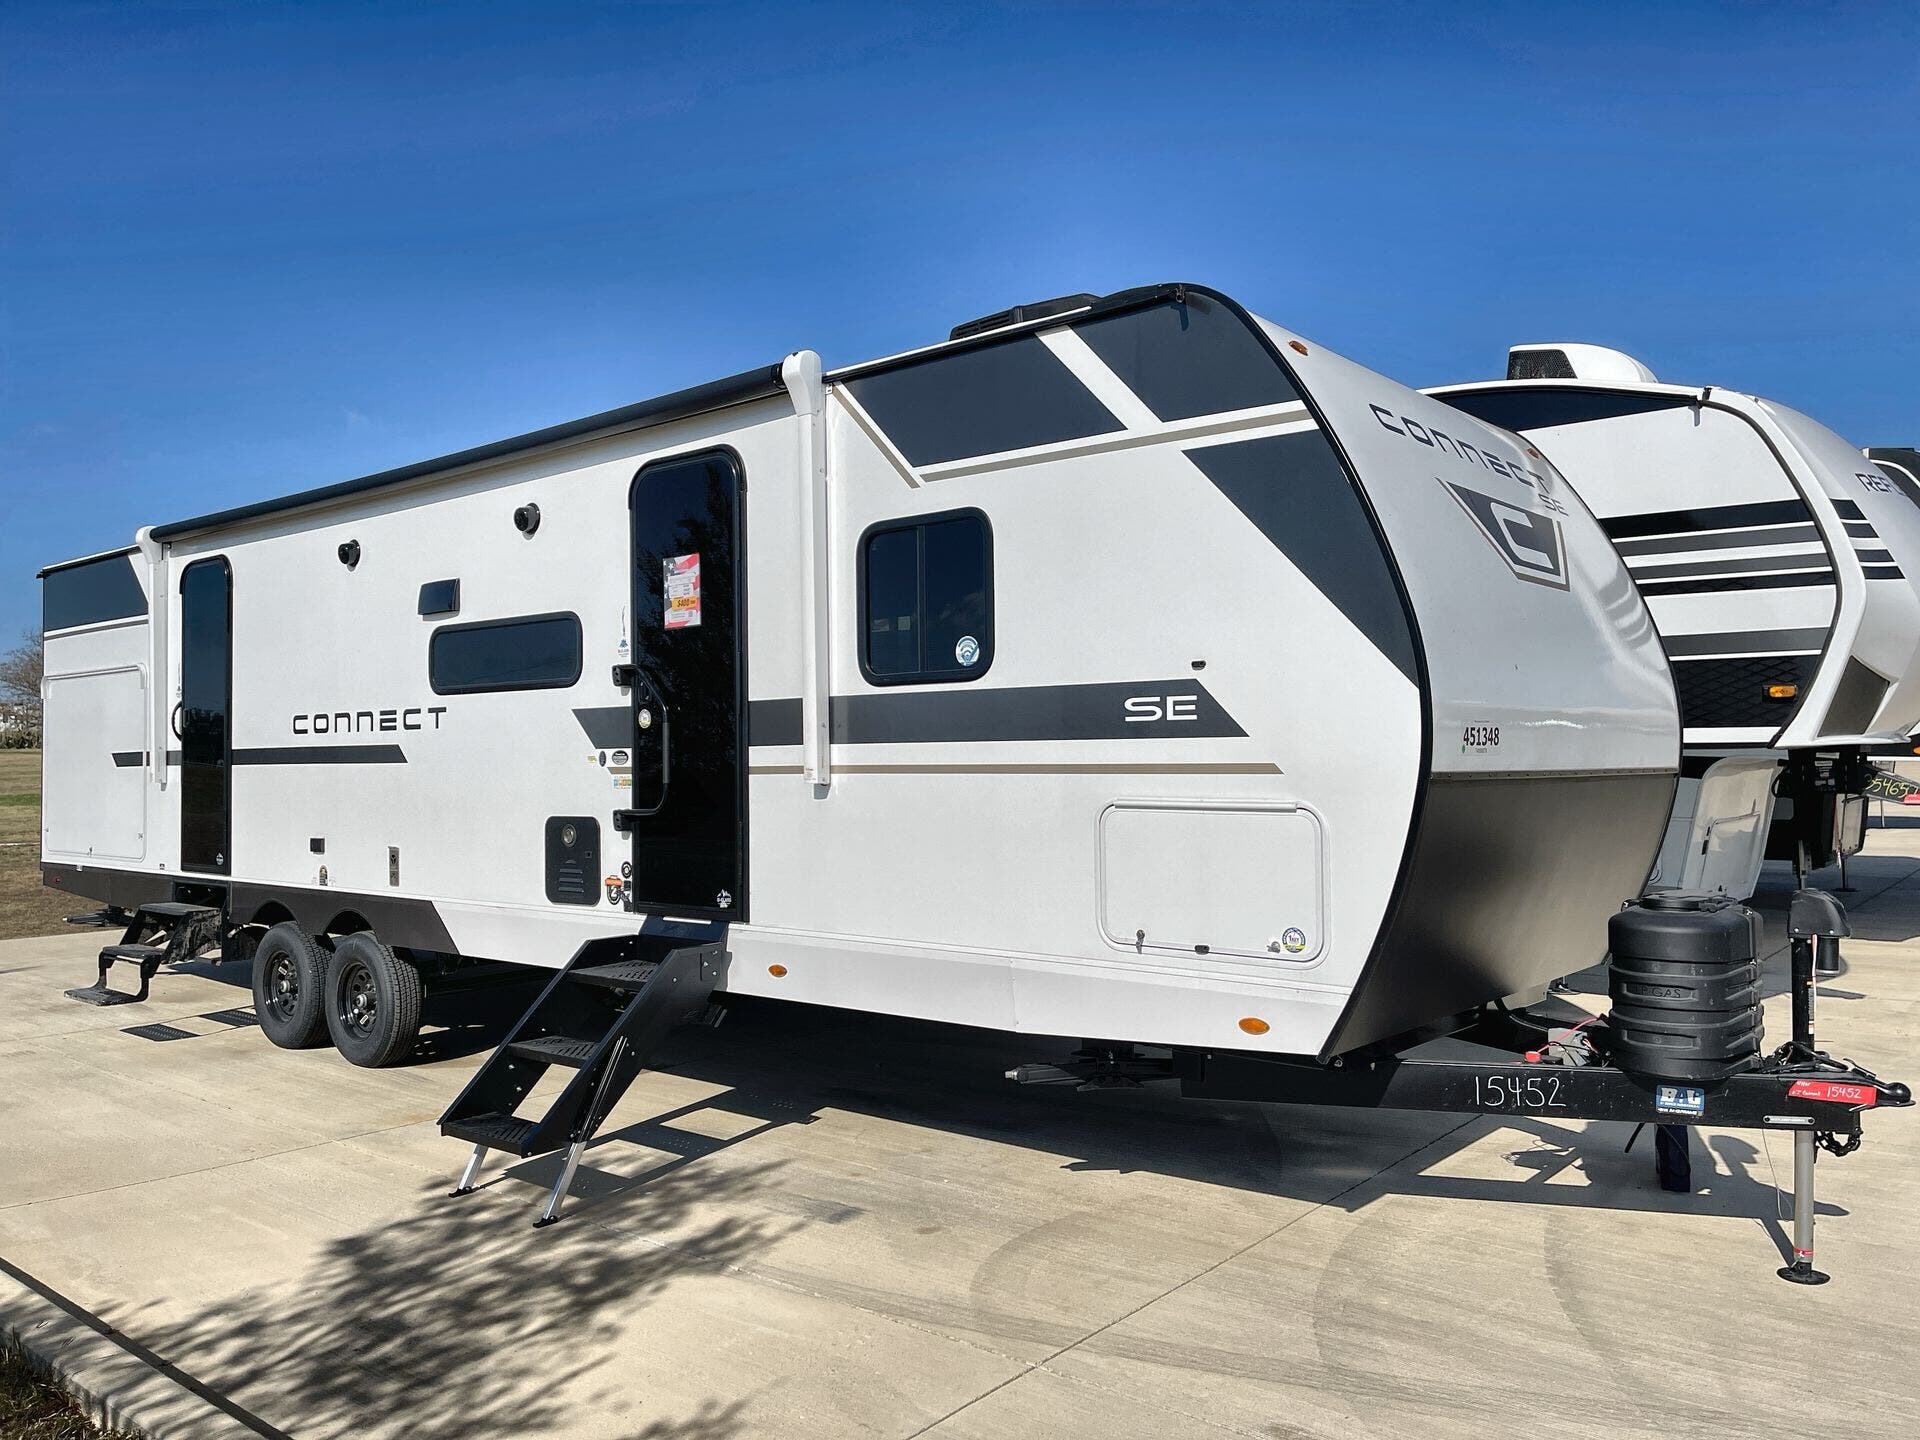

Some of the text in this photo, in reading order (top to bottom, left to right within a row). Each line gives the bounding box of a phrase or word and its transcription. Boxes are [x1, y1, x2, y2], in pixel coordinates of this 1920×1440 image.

[1369, 403, 1550, 494] CONNECT
[1538, 493, 1569, 516] SE
[1124, 695, 1198, 721] SE
[293, 707, 447, 734] CONNECT
[1463, 726, 1500, 746] 451348
[1651, 986, 1681, 998] GAS
[1475, 1076, 1567, 1107] 15452
[1826, 1085, 1862, 1099] 15452
